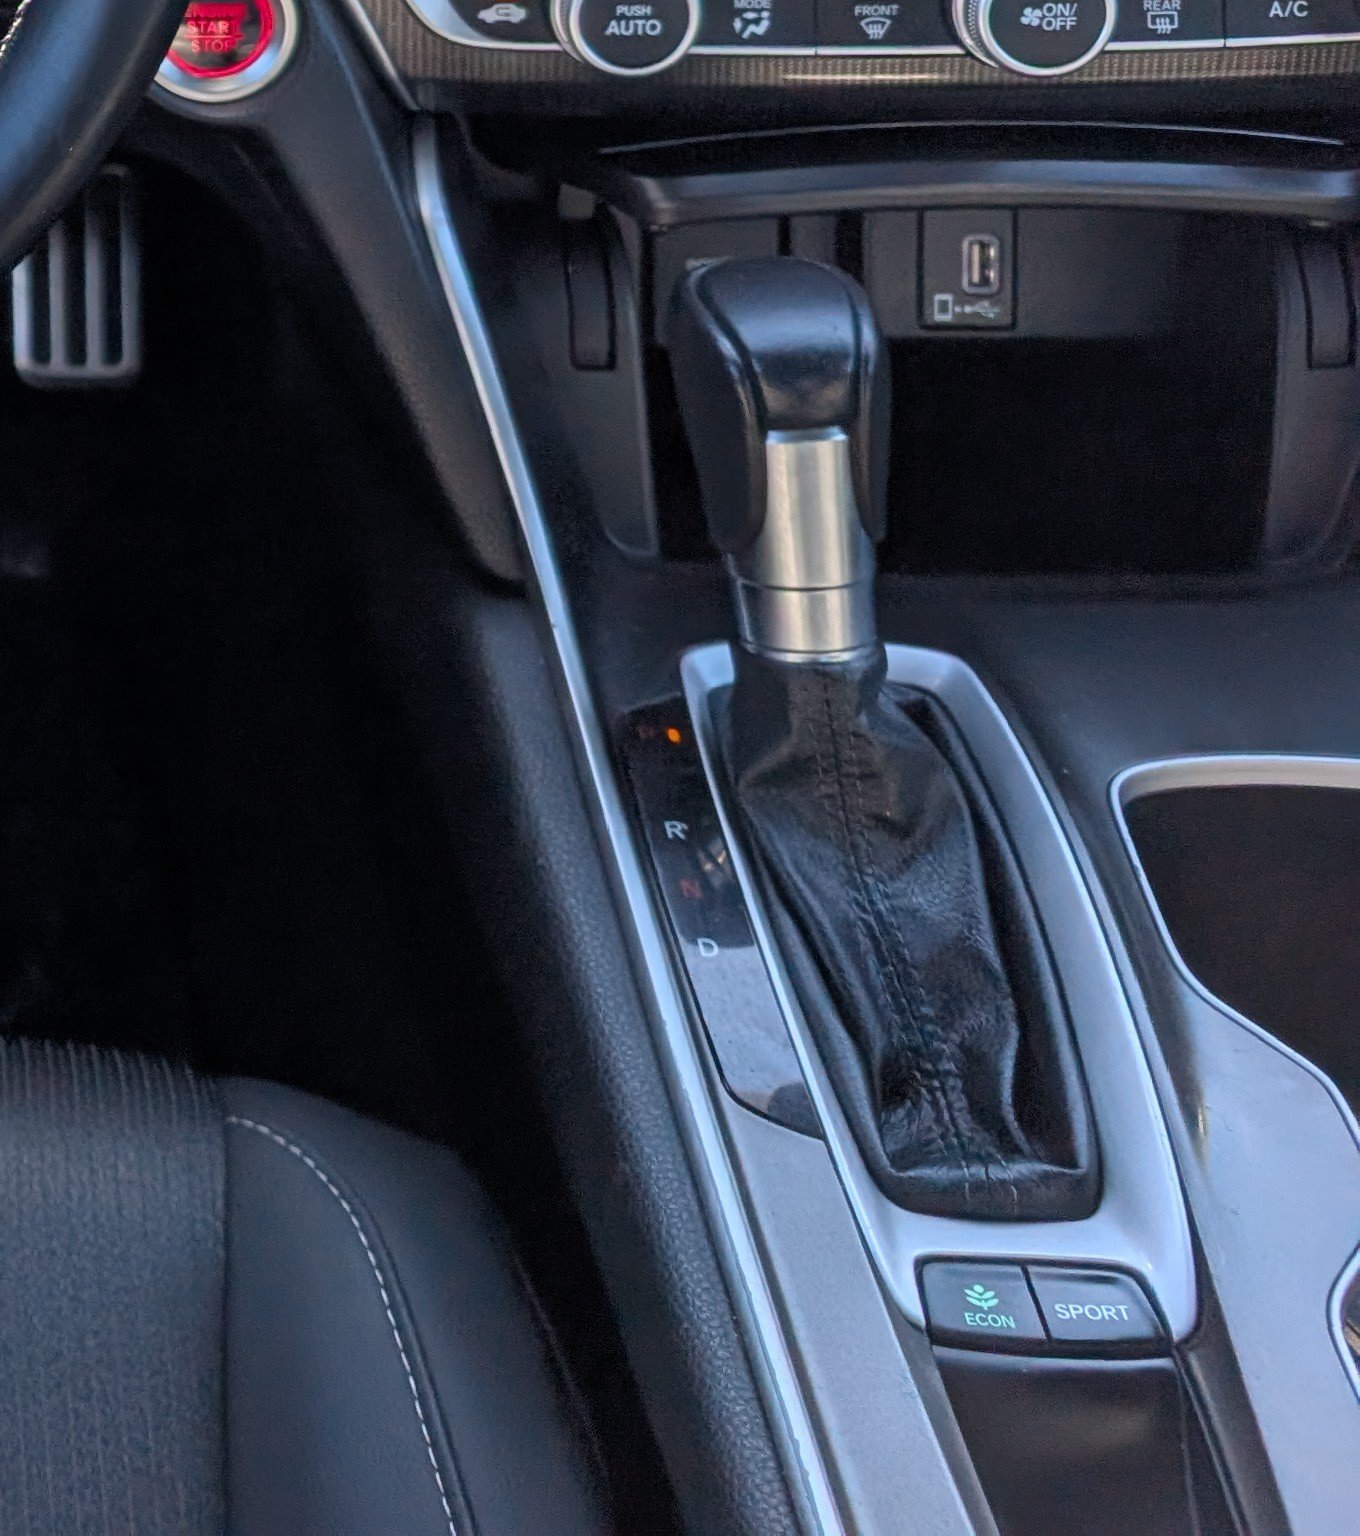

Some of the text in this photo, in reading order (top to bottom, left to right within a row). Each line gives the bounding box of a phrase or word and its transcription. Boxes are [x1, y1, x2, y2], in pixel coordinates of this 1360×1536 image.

[615, 4, 652, 17] PUSH
[854, 4, 899, 16] FRONT
[1041, 2, 1078, 17] ON/
[1268, 0, 1309, 18] A/C
[185, 20, 242, 33] START
[605, 19, 662, 36] AUTO
[1041, 17, 1078, 31] OFF
[190, 39, 236, 53] STOP
[663, 820, 685, 840] R
[697, 937, 719, 957] D
[963, 1311, 1017, 1329] ECON
[1053, 1304, 1129, 1322] SPORT
